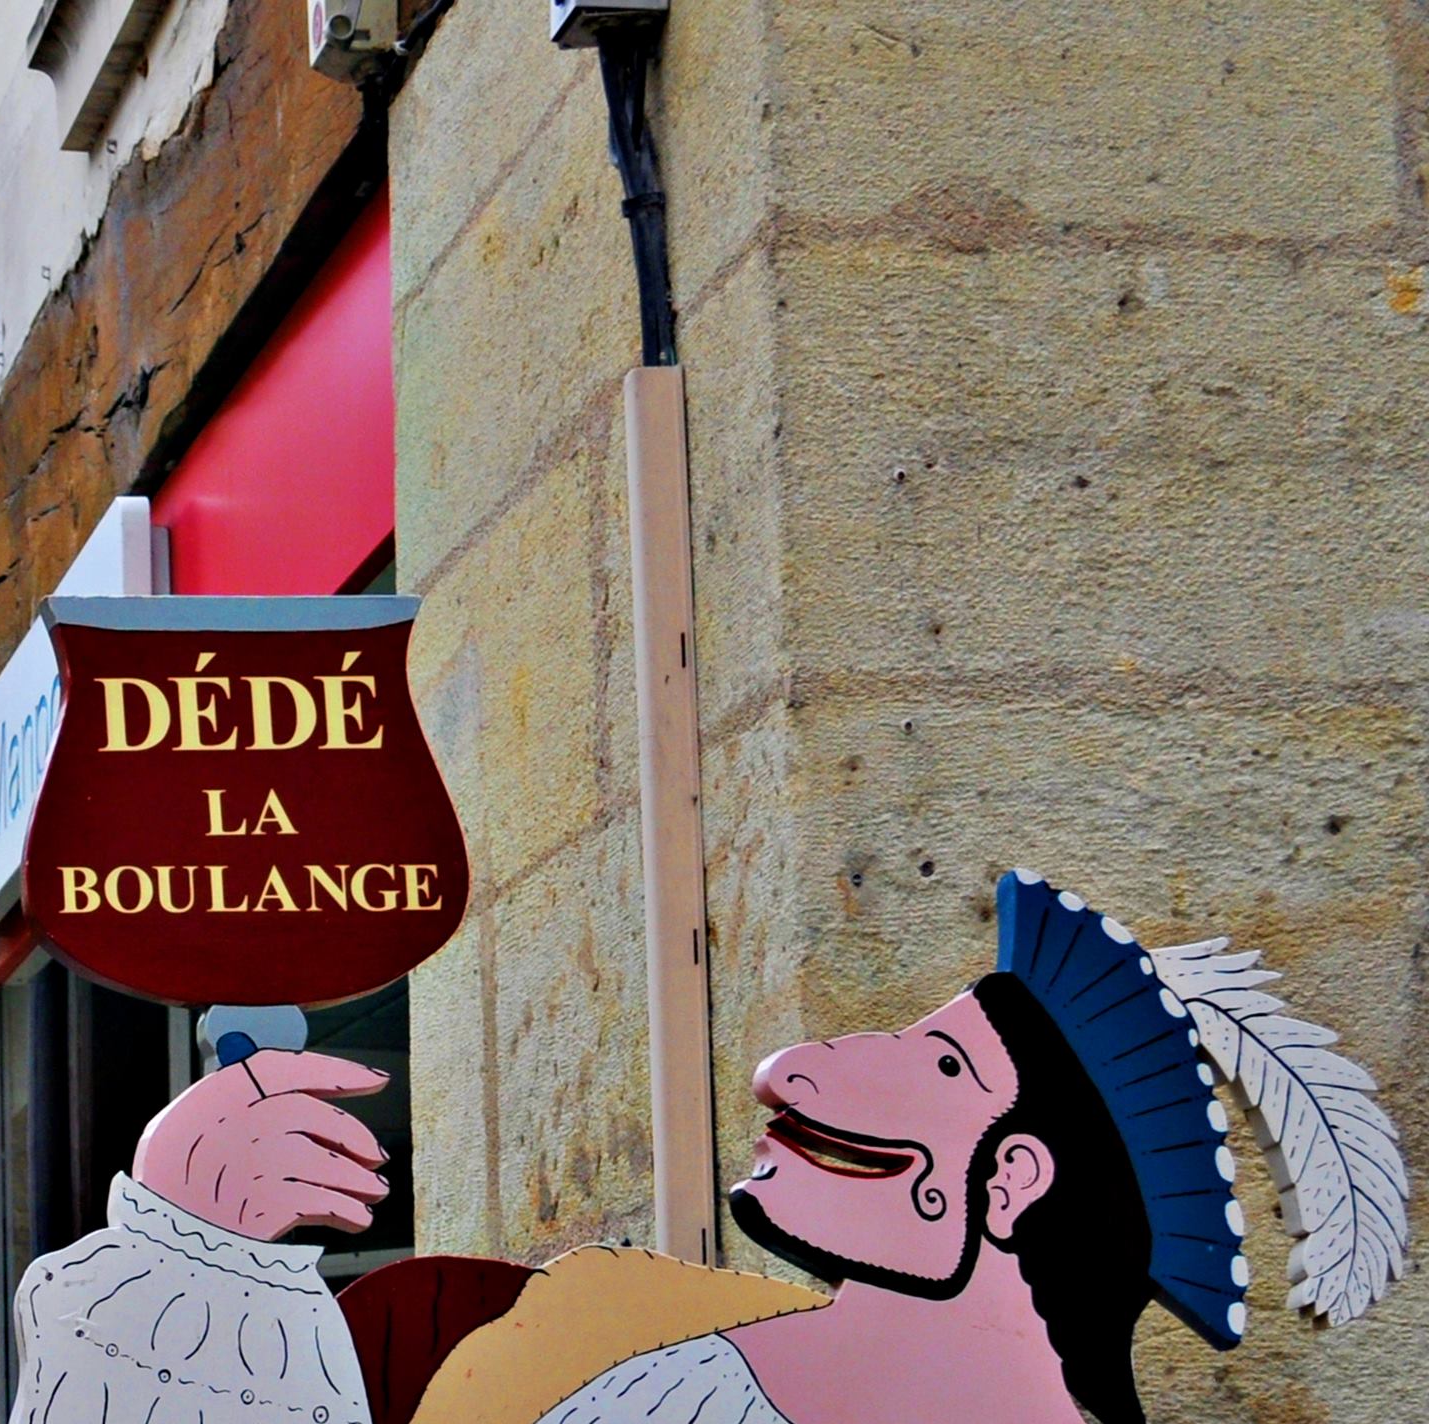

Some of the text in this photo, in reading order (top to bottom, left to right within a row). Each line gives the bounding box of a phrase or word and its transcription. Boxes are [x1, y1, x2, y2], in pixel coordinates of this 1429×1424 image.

[94, 651, 384, 752] DÉDÉ
[202, 788, 299, 836] LA
[57, 863, 442, 914] BOULANGE
